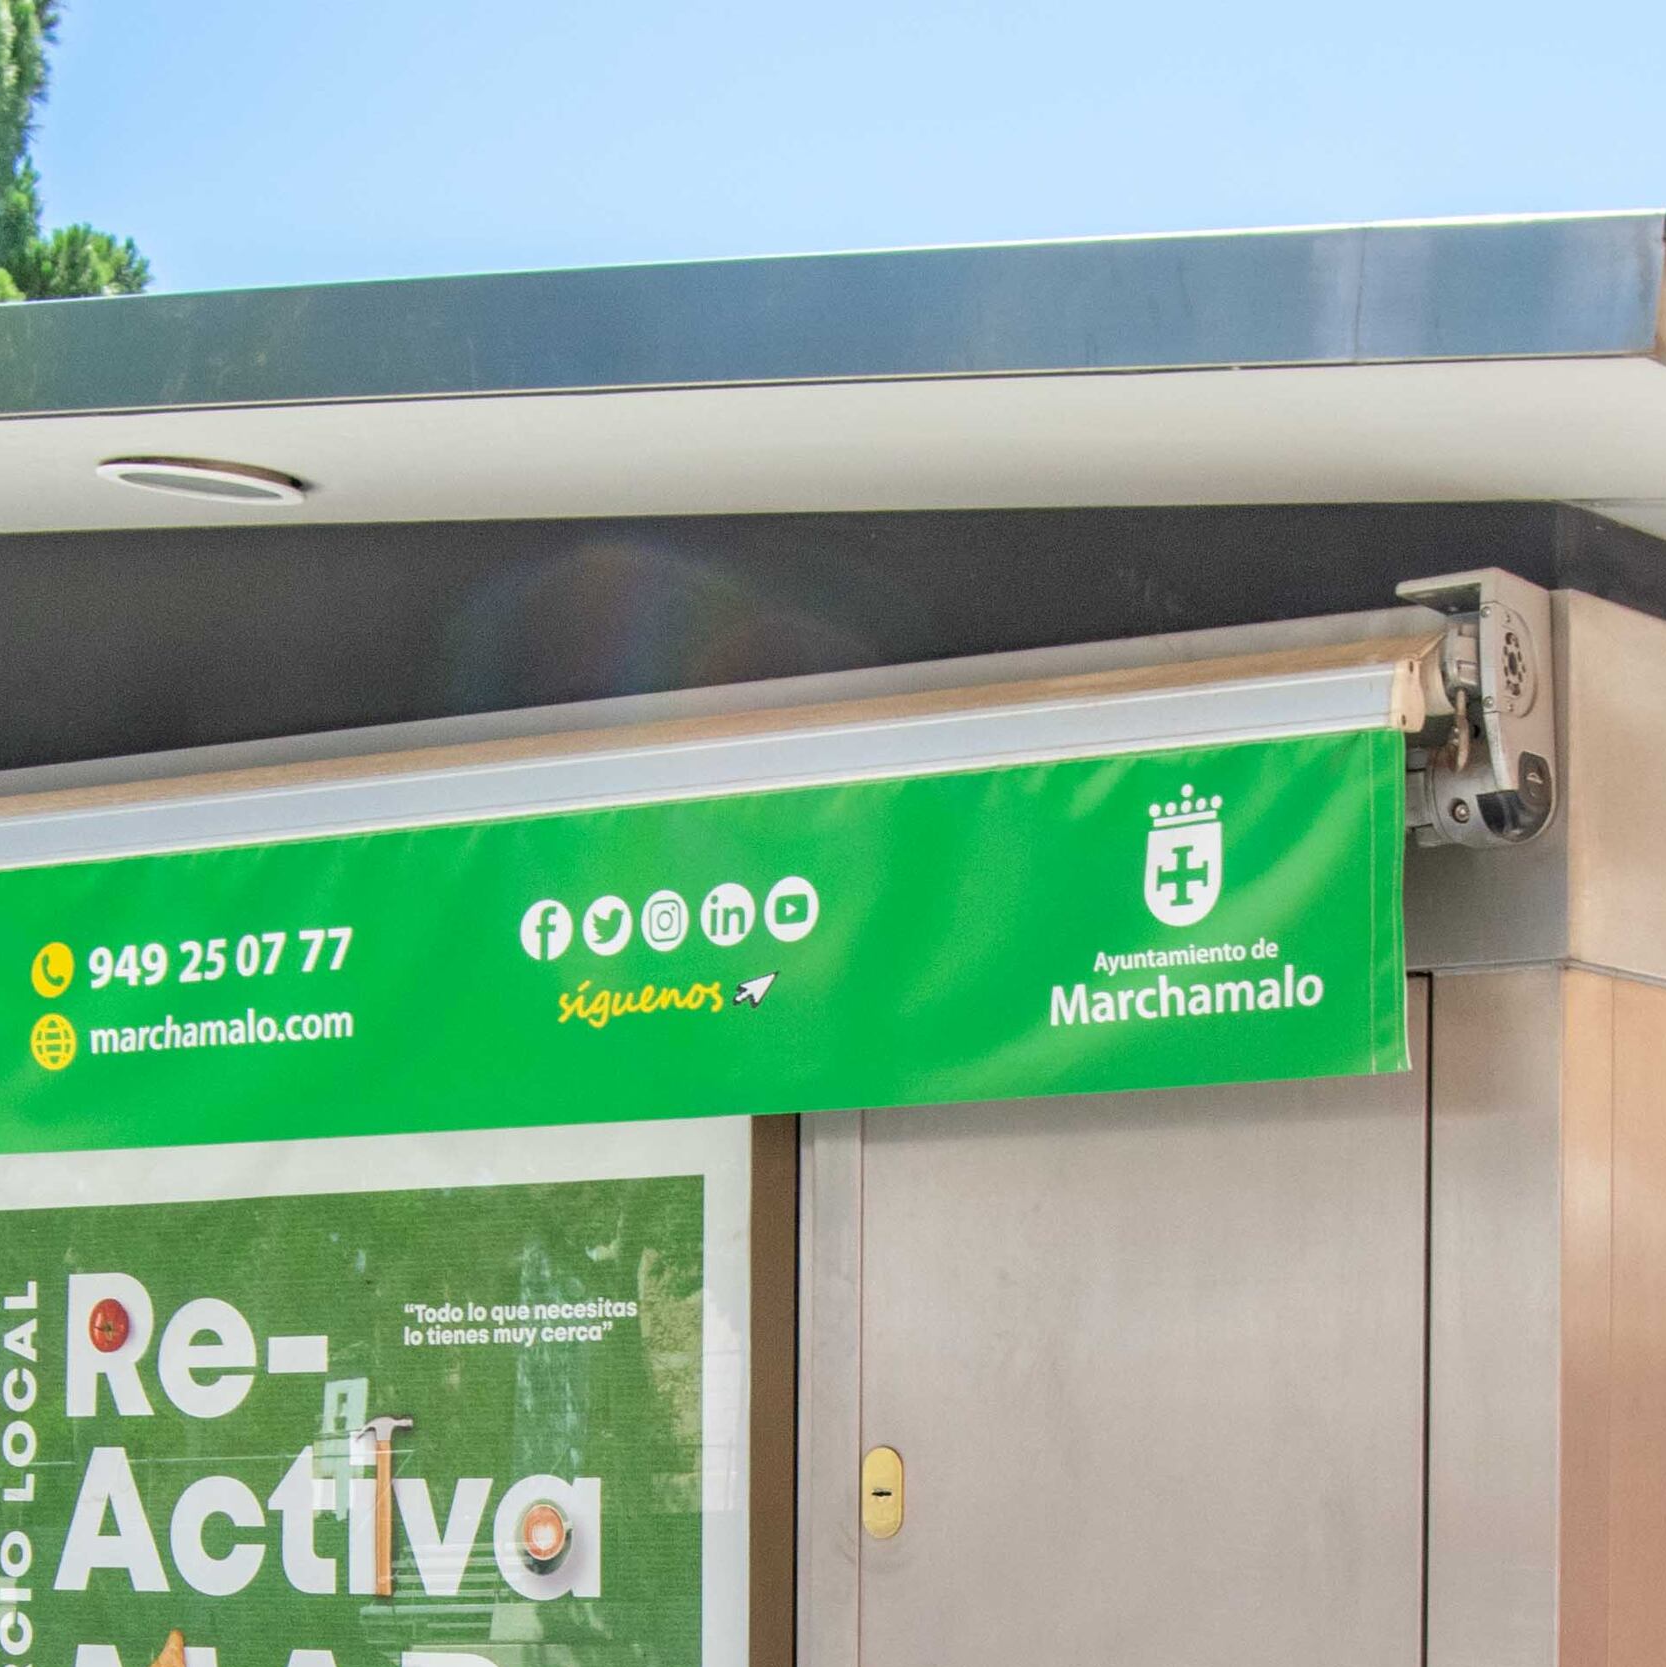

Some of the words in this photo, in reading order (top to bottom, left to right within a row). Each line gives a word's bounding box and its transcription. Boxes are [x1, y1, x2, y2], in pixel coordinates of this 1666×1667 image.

[88, 943, 168, 989] 949
[179, 938, 227, 983] 25
[235, 931, 287, 977] 07
[298, 927, 352, 973] 77
[1094, 943, 1246, 976] Ayuntamiento
[1251, 938, 1278, 959] de
[557, 980, 724, 1028] síguenos
[1050, 964, 1323, 1026] Marchamalo
[90, 1007, 353, 1055] marchamalo.com
[403, 1326, 423, 1346] lo
[426, 1324, 489, 1345] tienes
[493, 1327, 537, 1347] muy
[540, 1321, 614, 1342] cerca”
[404, 1303, 464, 1323] “Todo
[468, 1302, 487, 1322] lo
[491, 1304, 530, 1325] que
[534, 1297, 637, 1319] necesitas
[65, 1272, 329, 1419] Re-
[2, 1280, 37, 1501] LOCAL
[53, 1430, 602, 1602] Activa
